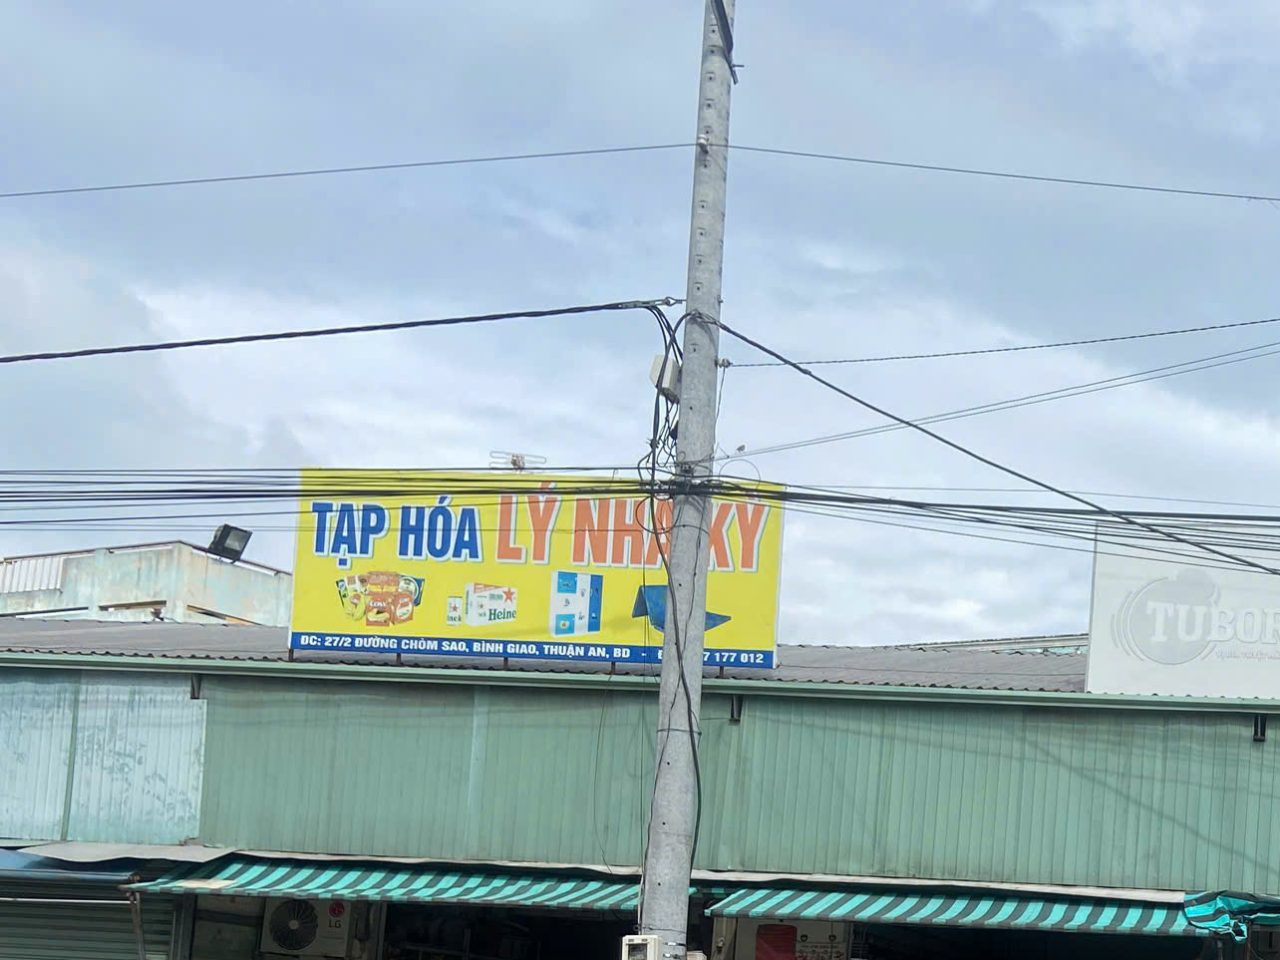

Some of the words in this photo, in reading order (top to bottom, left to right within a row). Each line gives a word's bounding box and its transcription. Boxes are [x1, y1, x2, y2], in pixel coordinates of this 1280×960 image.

[311, 501, 387, 567] TẠP
[398, 495, 480, 560] HÓA
[496, 481, 558, 562] LÝ
[324, 636, 351, 648] 27/2
[354, 635, 398, 649] ĐƯỜNG
[441, 640, 469, 653] SAO,
[472, 639, 503, 653] BÌNH
[507, 643, 540, 656] GIAO,
[543, 644, 585, 658] THUẬN
[587, 647, 609, 659] AN,
[613, 648, 630, 658] BD
[714, 652, 737, 662] 177
[740, 653, 764, 663] 012
[328, 920, 341, 928] LG
